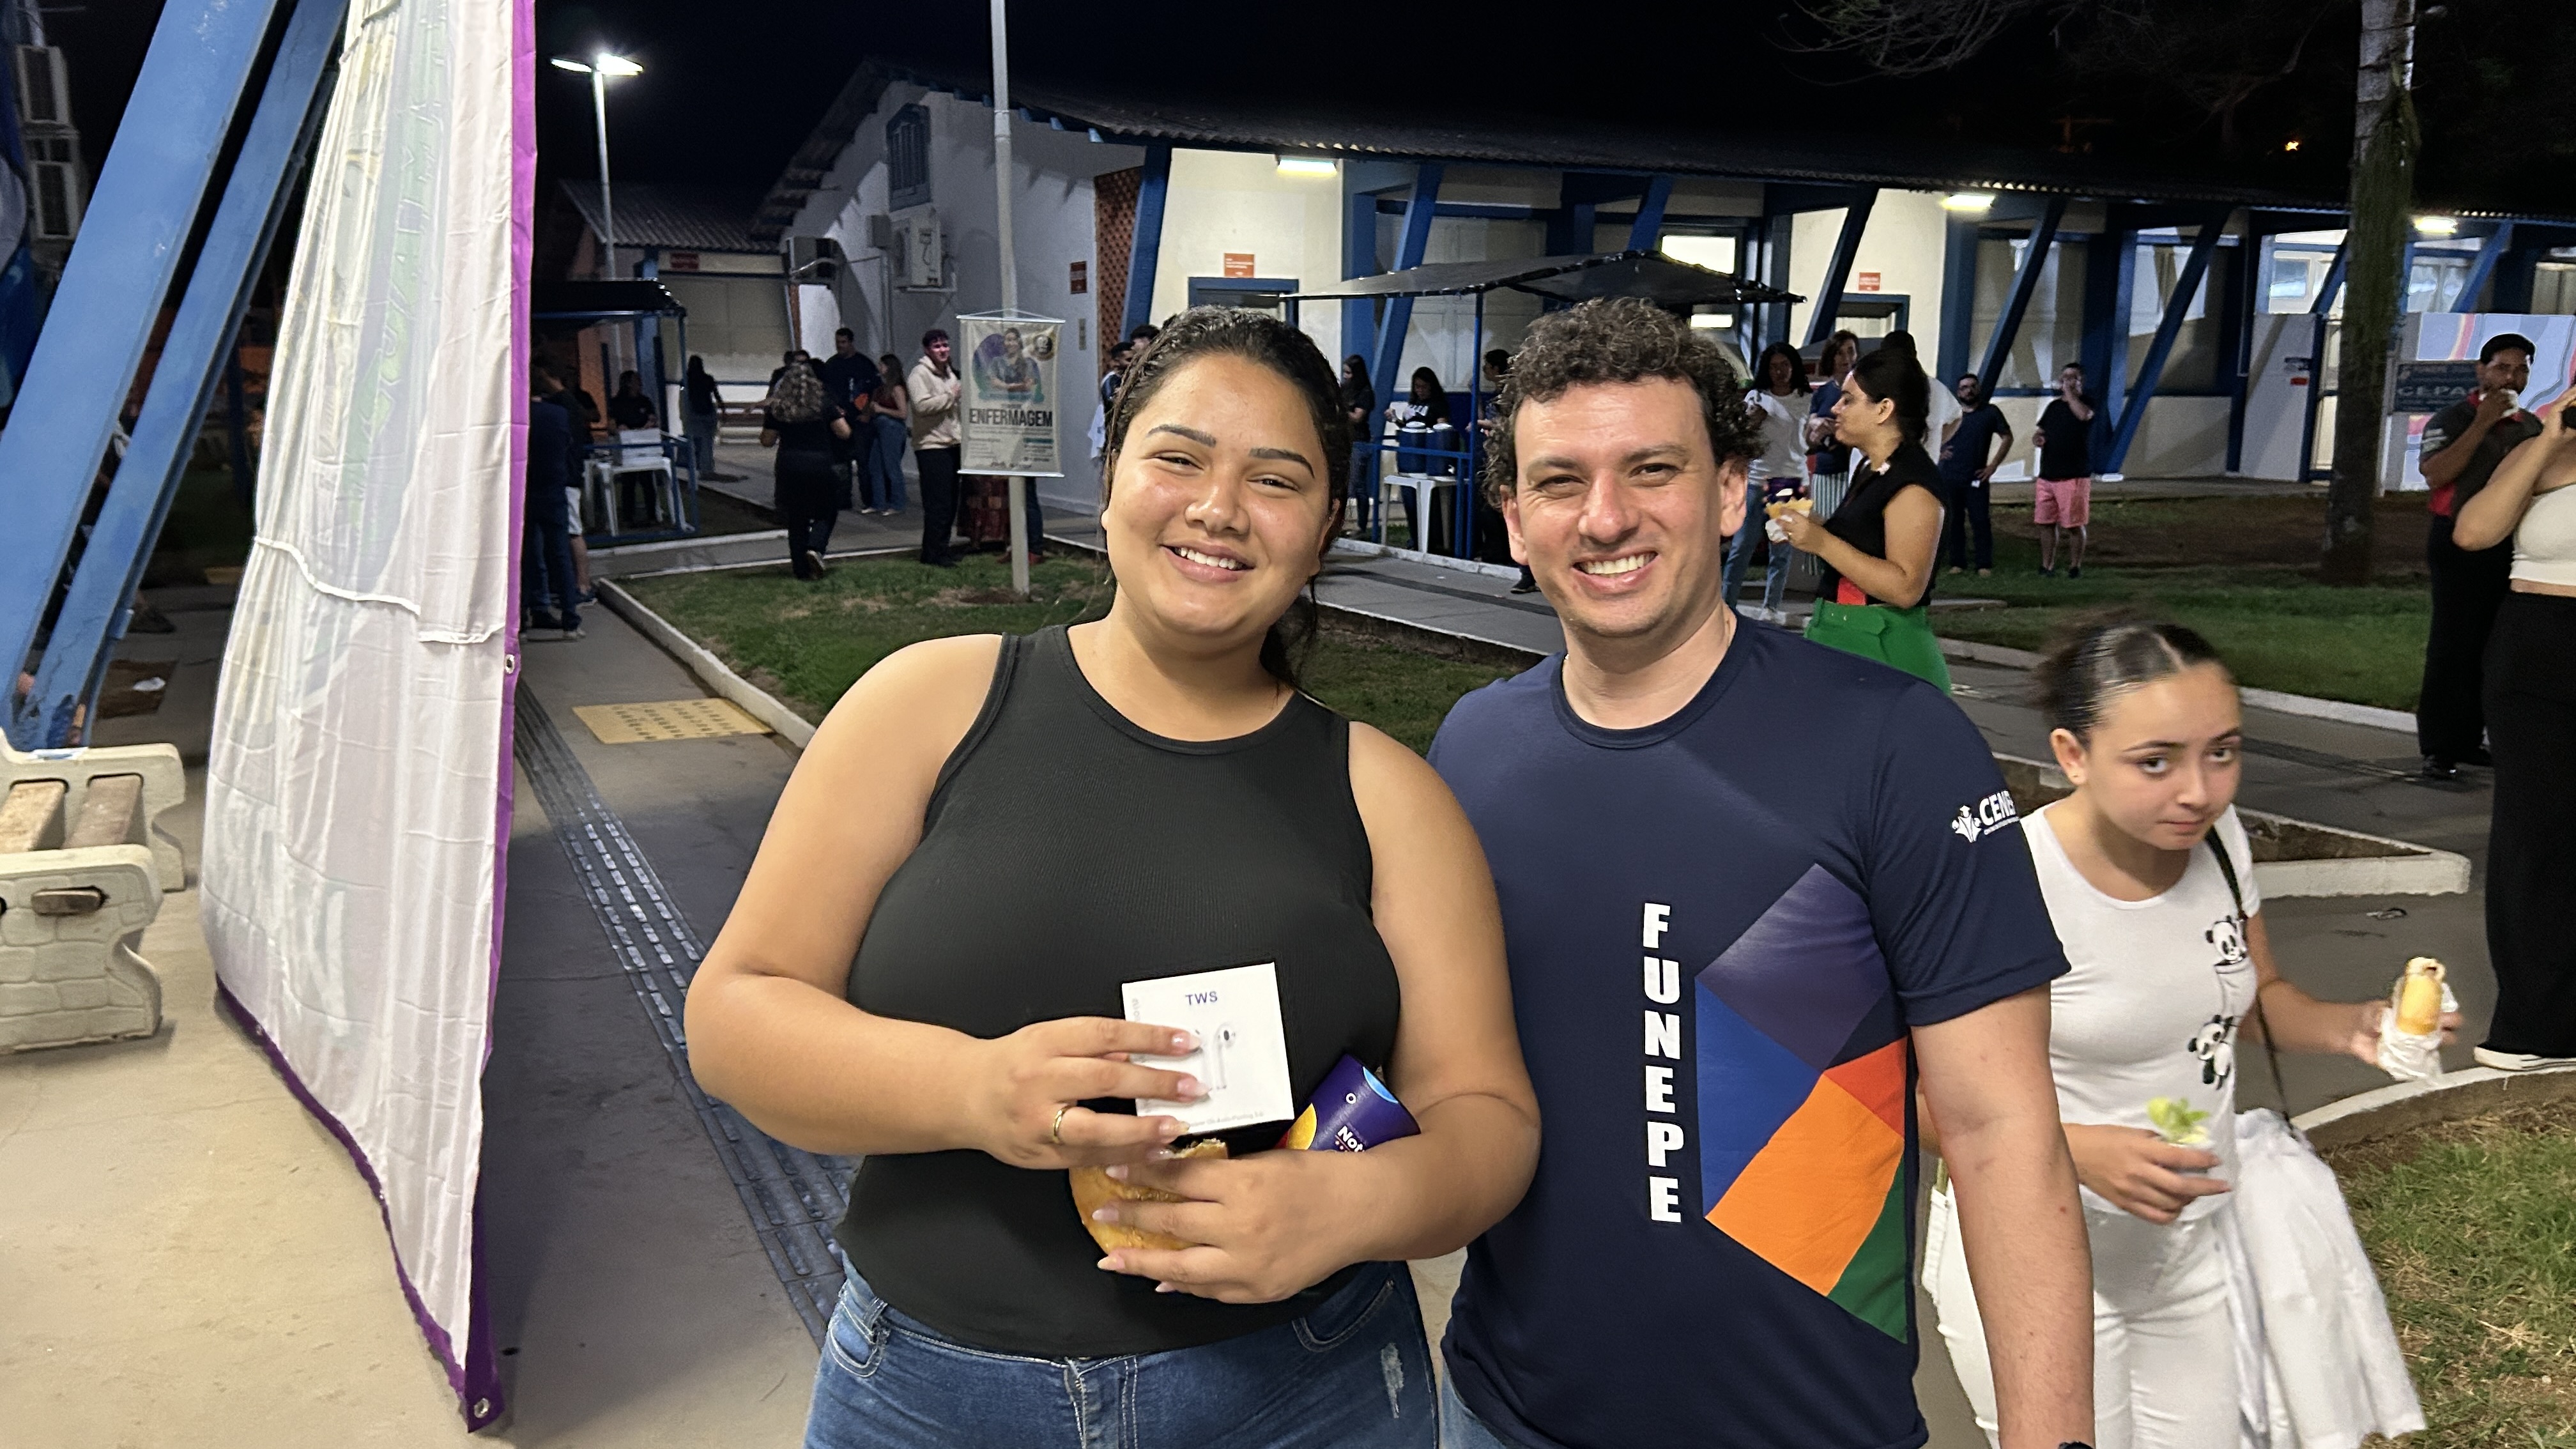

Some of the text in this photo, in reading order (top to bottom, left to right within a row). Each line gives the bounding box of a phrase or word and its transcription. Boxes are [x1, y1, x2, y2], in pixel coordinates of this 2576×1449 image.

[969, 408, 1053, 427] ENFERMAGEM
[1185, 990, 1218, 1007] TWS
[1643, 903, 1684, 1223] FUNEPE
